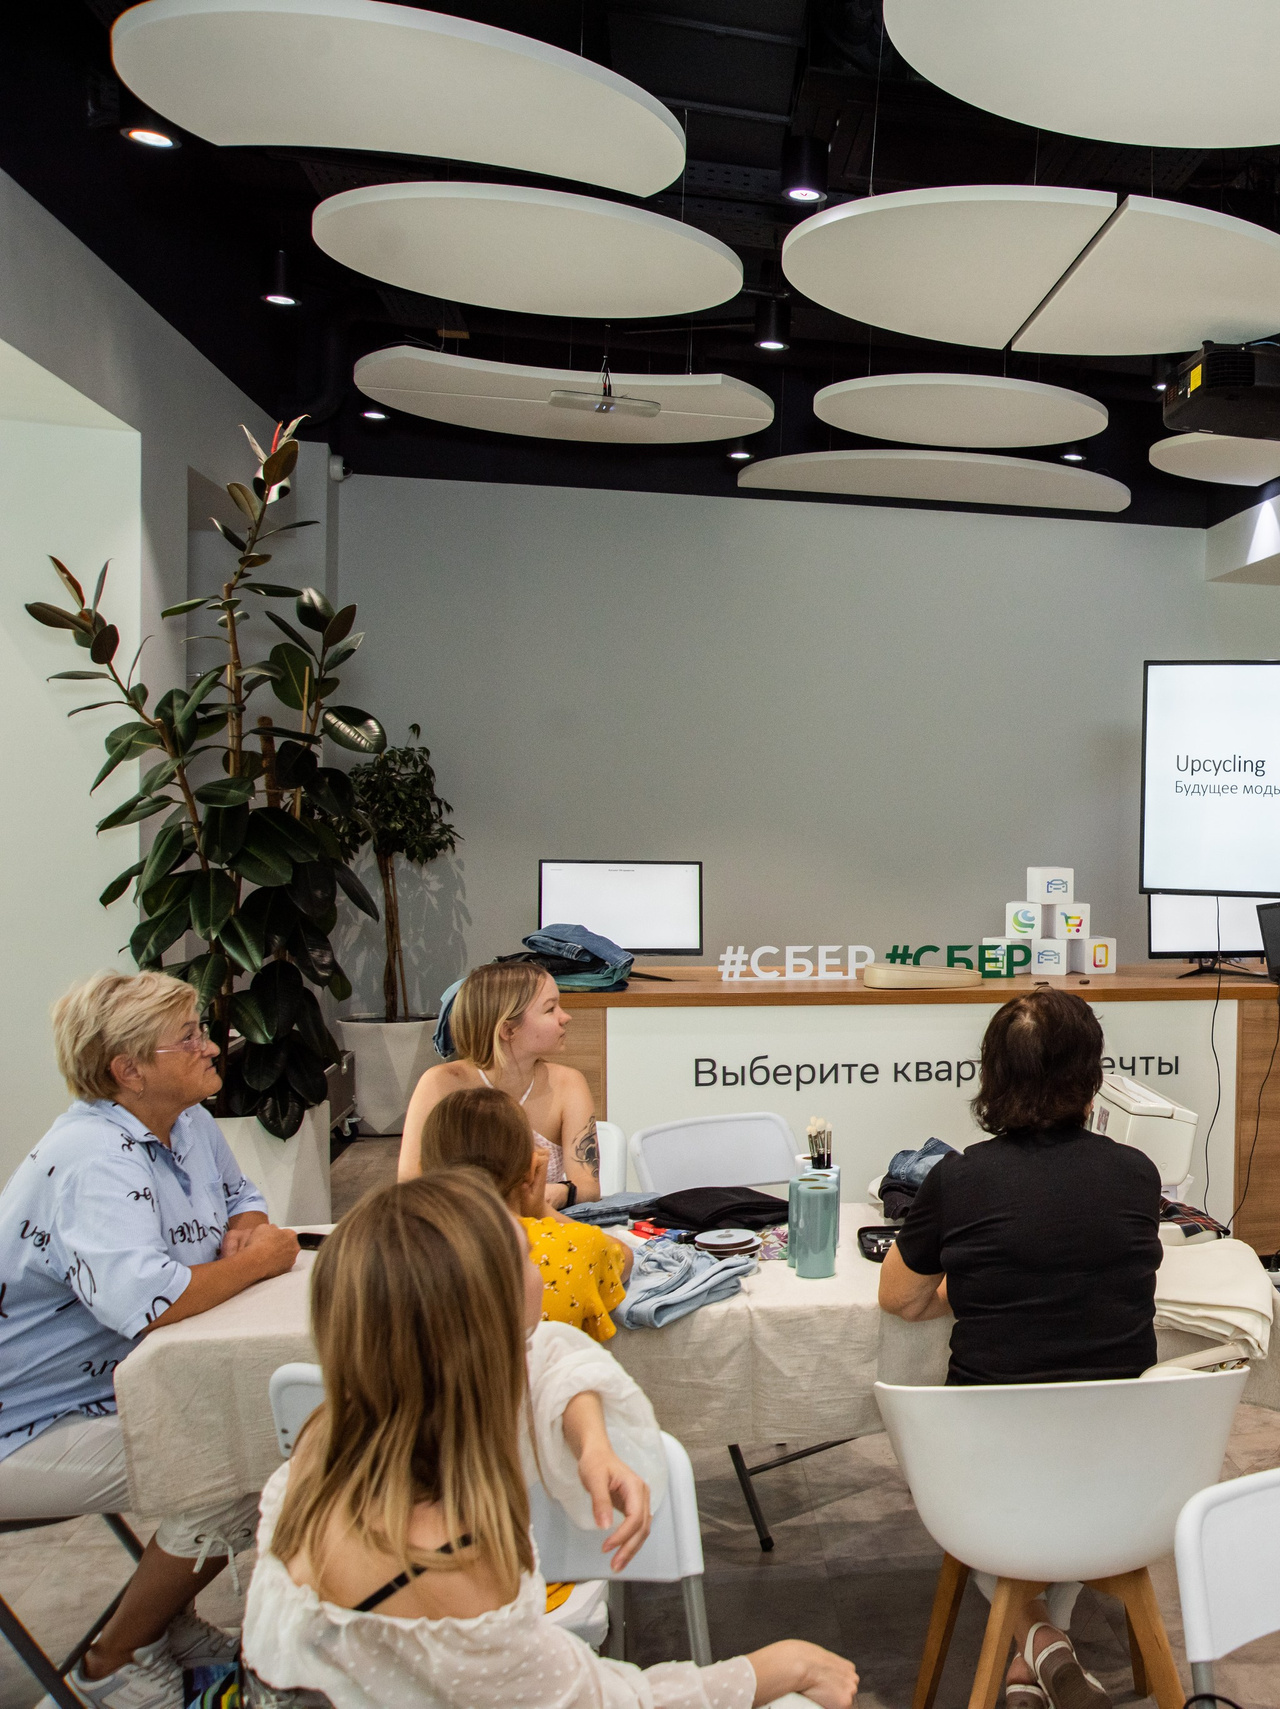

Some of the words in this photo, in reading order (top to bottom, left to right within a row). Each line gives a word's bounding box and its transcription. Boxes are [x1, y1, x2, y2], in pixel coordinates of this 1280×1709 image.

[1176, 754, 1266, 777] Upcycling
[1175, 780, 1239, 797] Будущее
[718, 945, 875, 979] #СБЕР
[694, 1055, 880, 1092] Выберите
[893, 1060, 982, 1088] квар
[1100, 1056, 1179, 1077] ечты
